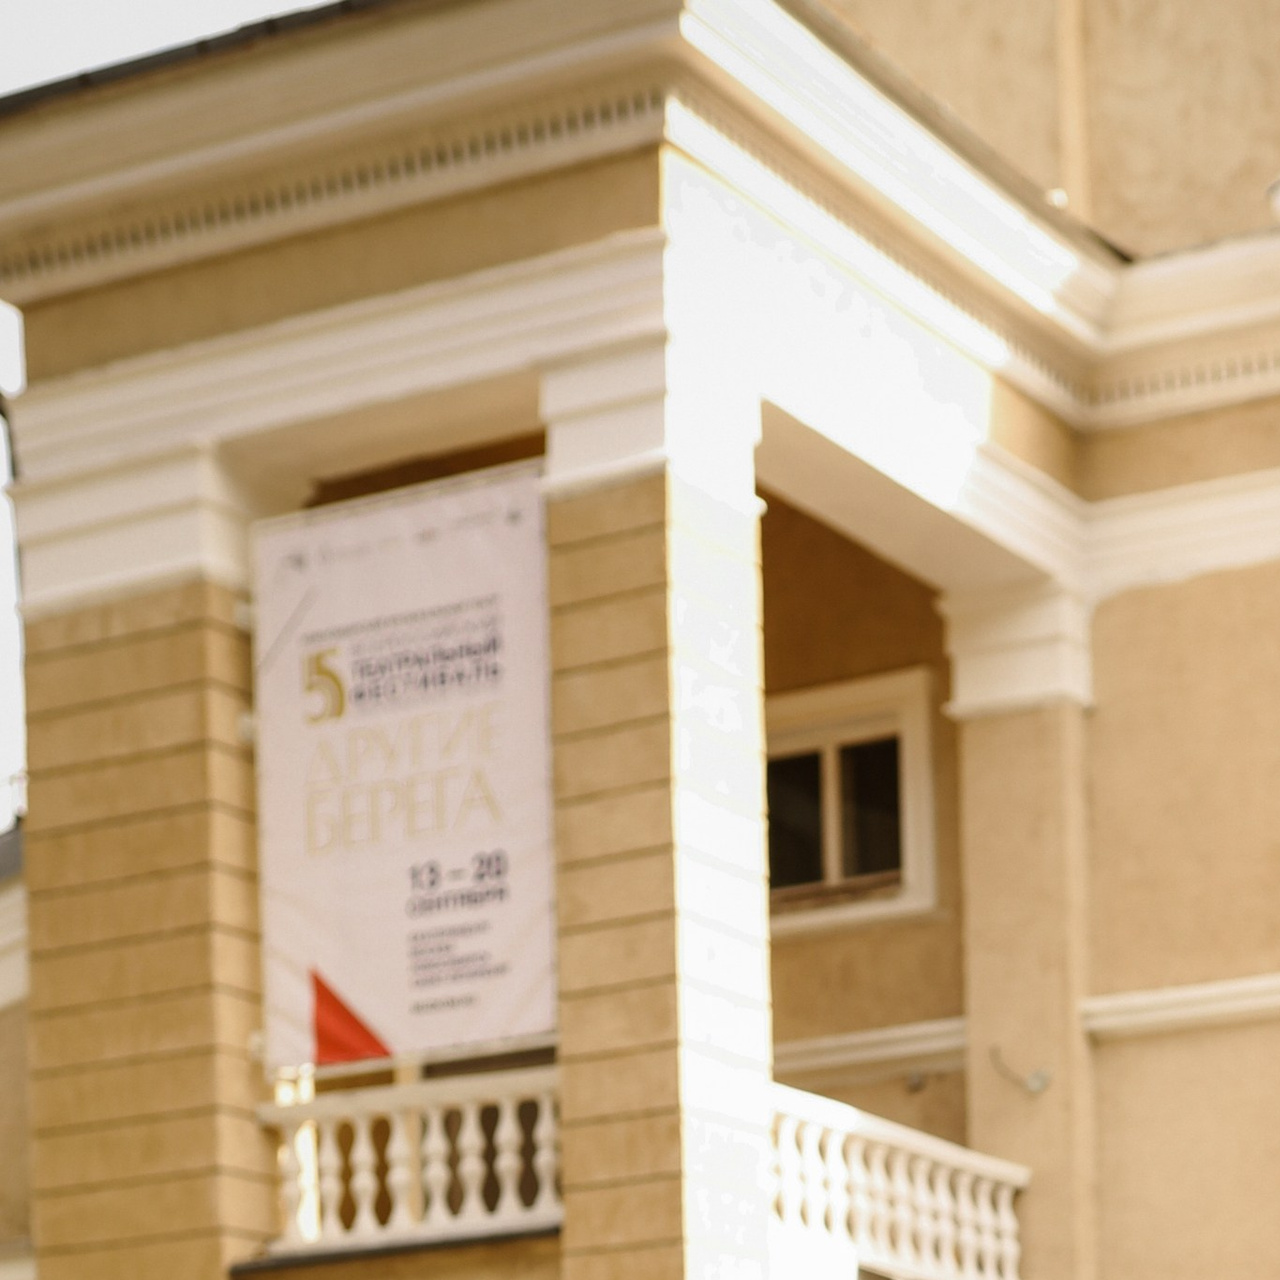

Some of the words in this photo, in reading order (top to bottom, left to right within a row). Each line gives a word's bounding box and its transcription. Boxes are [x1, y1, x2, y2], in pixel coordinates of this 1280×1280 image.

[303, 647, 345, 726] 5
[303, 700, 505, 787] ДРУГИЕ
[305, 768, 504, 857] БЕРЕГА
[407, 860, 441, 892] 13
[472, 850, 508, 882] 20
